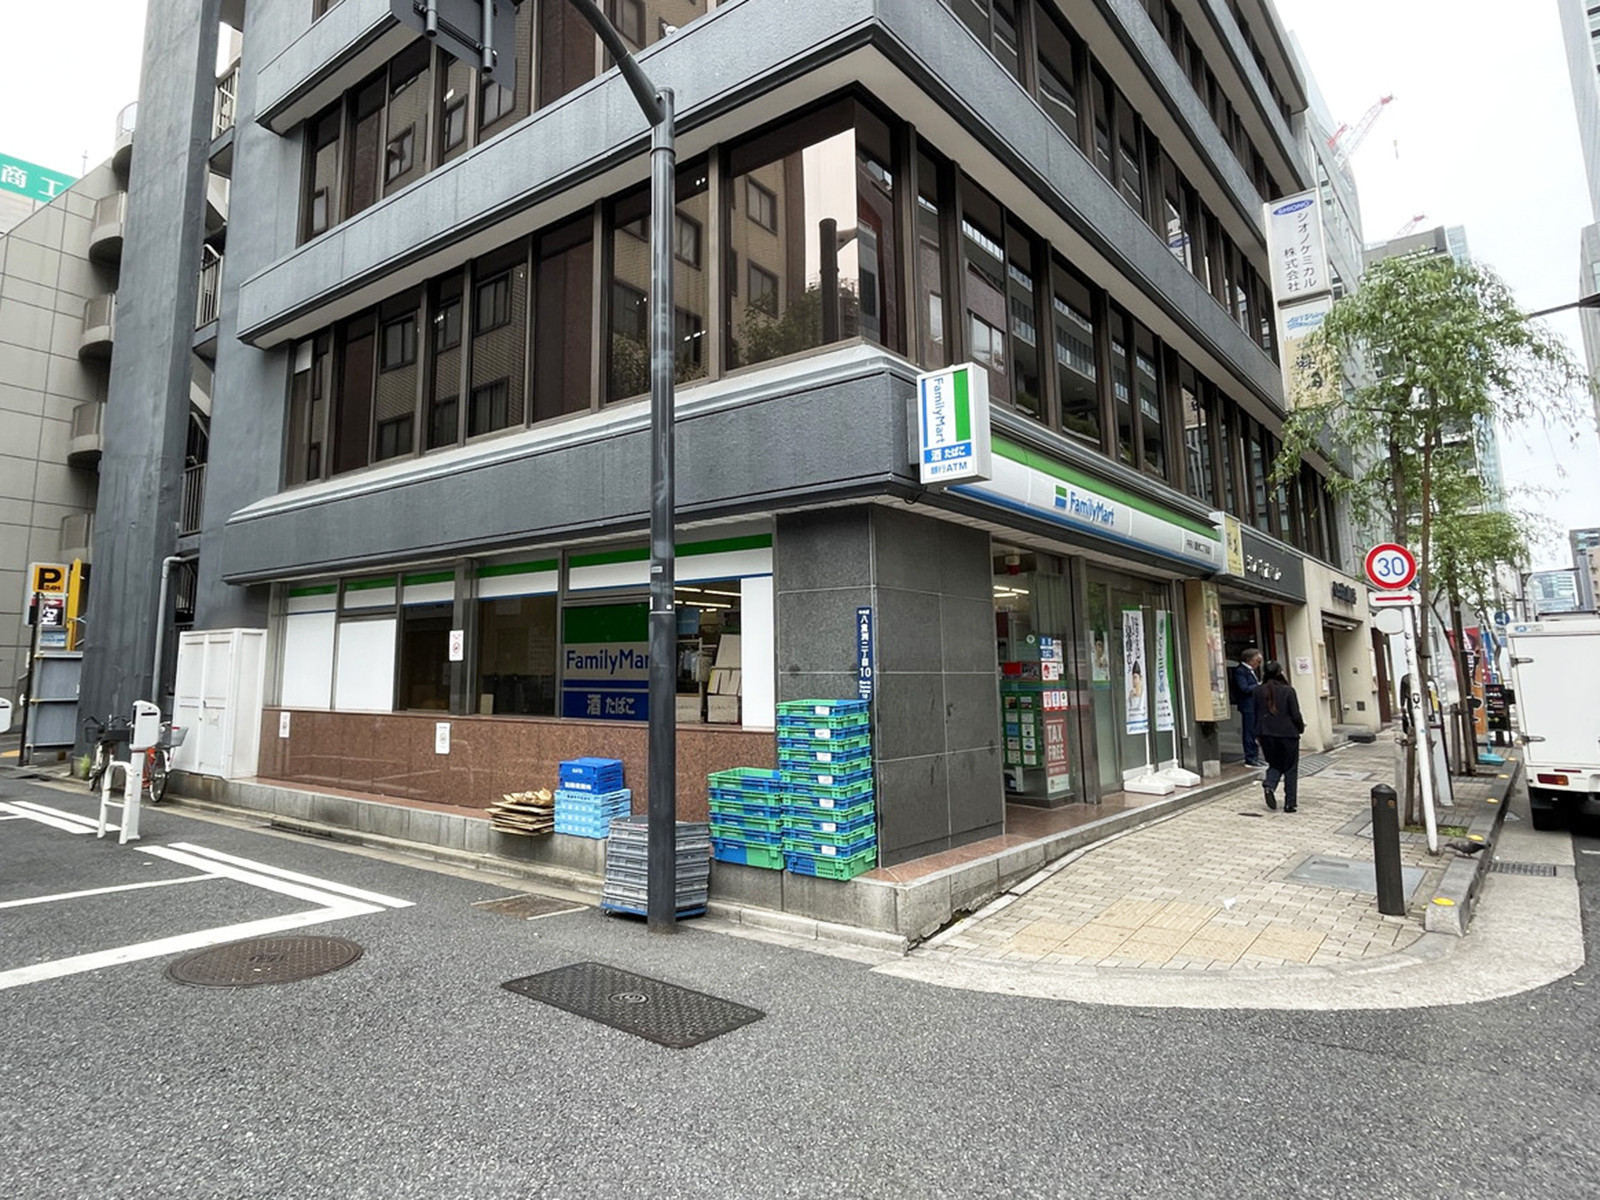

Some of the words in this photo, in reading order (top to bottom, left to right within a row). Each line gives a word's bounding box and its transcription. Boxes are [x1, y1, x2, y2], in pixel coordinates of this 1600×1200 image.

[1297, 212, 1317, 289] シオノケミカル
[1285, 248, 1301, 292] 株式会社
[932, 378, 946, 443] FamilyMart
[1069, 490, 1115, 526] FamilyMart
[1377, 556, 1405, 577] 30
[37, 567, 62, 590] P
[566, 649, 649, 676] FamilyMar
[859, 667, 872, 678] 10
[587, 694, 601, 715] 酒
[605, 696, 636, 715] たばこ
[1047, 725, 1064, 744] TAX
[1048, 744, 1065, 761] FREE
